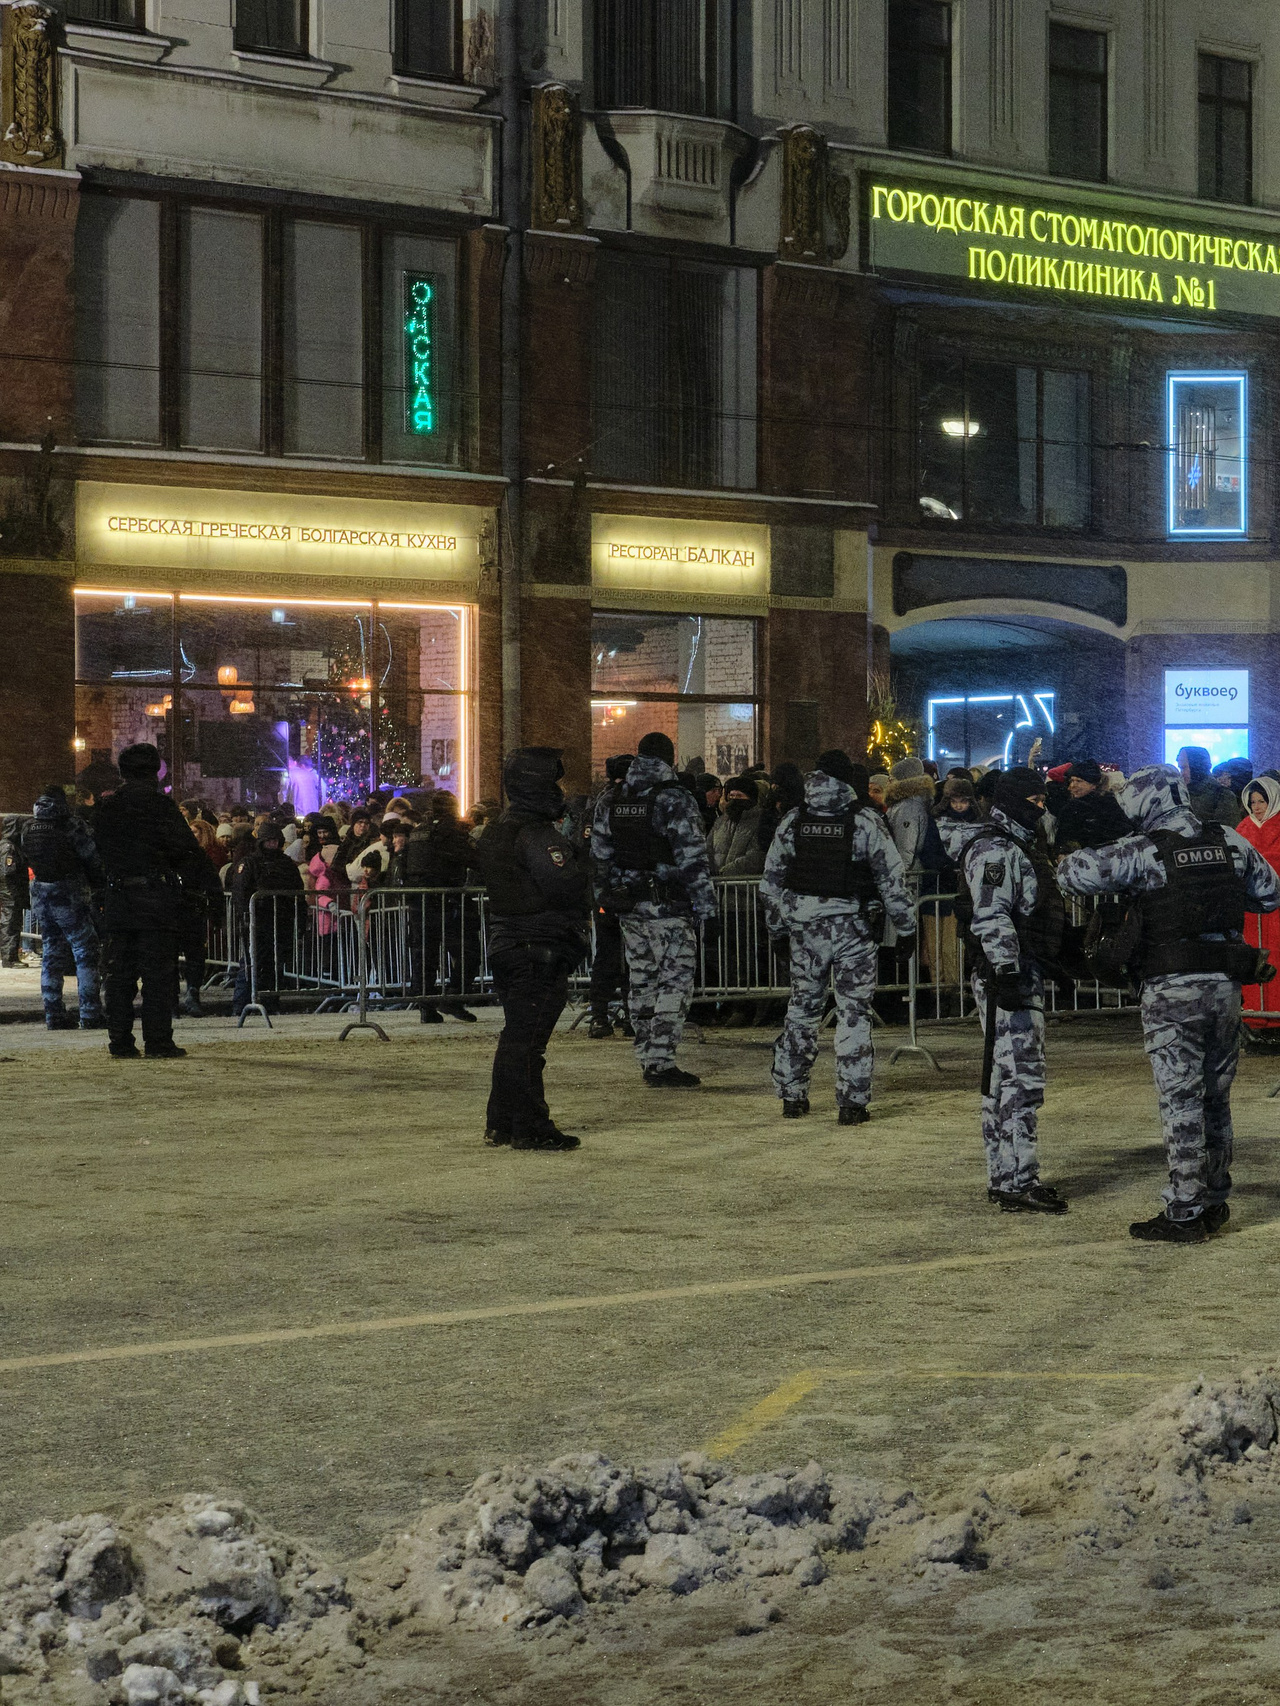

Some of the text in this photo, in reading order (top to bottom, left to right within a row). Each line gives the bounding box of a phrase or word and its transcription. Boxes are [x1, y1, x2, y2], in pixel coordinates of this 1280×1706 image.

[872, 186, 1025, 238] ГОРОДСКАЯ
[969, 247, 1216, 310] ПОЛИКЛИНИКА №1
[108, 516, 457, 550] СЕРБСКАЯ ГРЕЧЕСКАЯ БОЛГАРСКАЯ КУХНЯ
[611, 544, 755, 566] РЕСТОРАН БАЛКАН
[1175, 683, 1238, 701] буквоед
[615, 806, 646, 815] ОМОН
[802, 825, 842, 836] ОМОН
[1177, 849, 1225, 864] ОМОН
